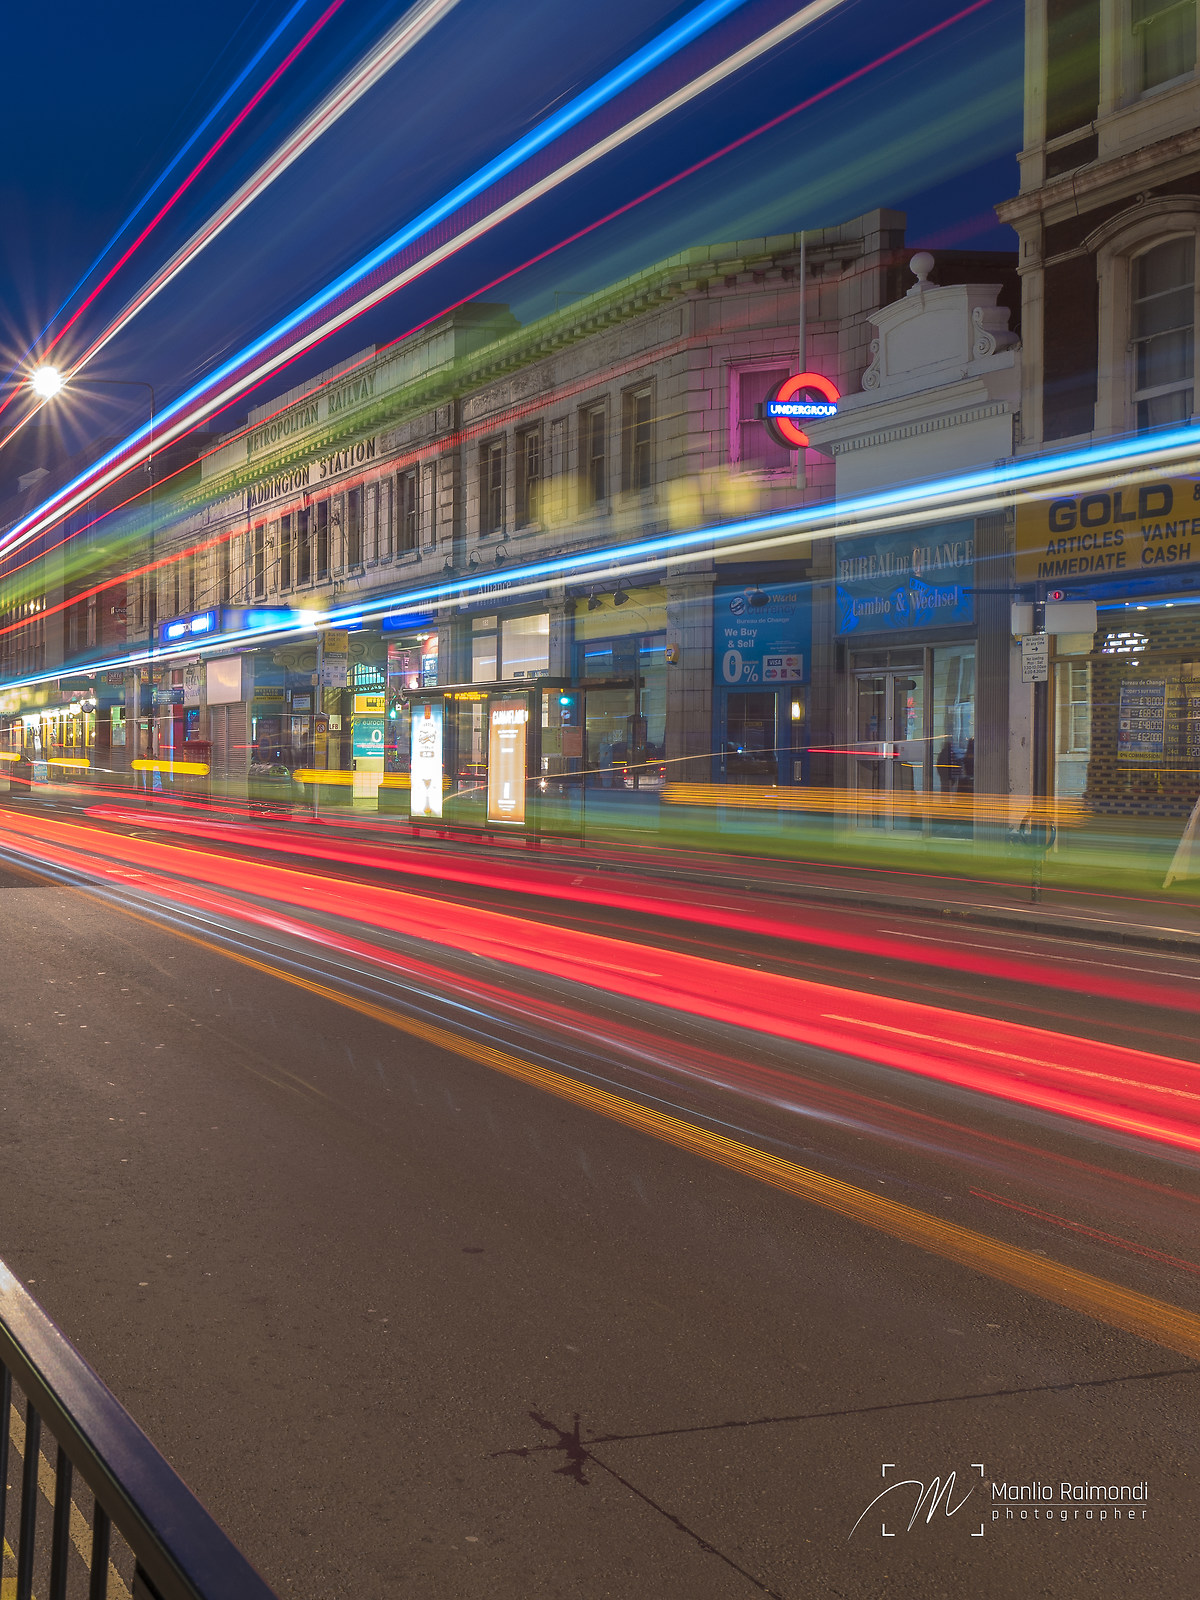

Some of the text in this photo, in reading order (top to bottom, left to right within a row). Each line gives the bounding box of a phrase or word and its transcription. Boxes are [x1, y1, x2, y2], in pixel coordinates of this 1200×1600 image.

[247, 372, 376, 454] METROPOLITAN RAILWAY
[320, 437, 376, 478] STATION
[1048, 484, 1174, 533] GOLD
[1046, 529, 1125, 556] ARTICLES
[840, 552, 895, 583] BUREAU
[912, 540, 974, 574] CHANGE
[1038, 542, 1192, 579] IMMEDIATE CASH
[747, 604, 797, 616] Currency
[852, 586, 959, 617] Cambio & Wechsel
[724, 628, 758, 638] We Buy
[728, 639, 754, 648] & Sell
[722, 649, 759, 683] 0%
